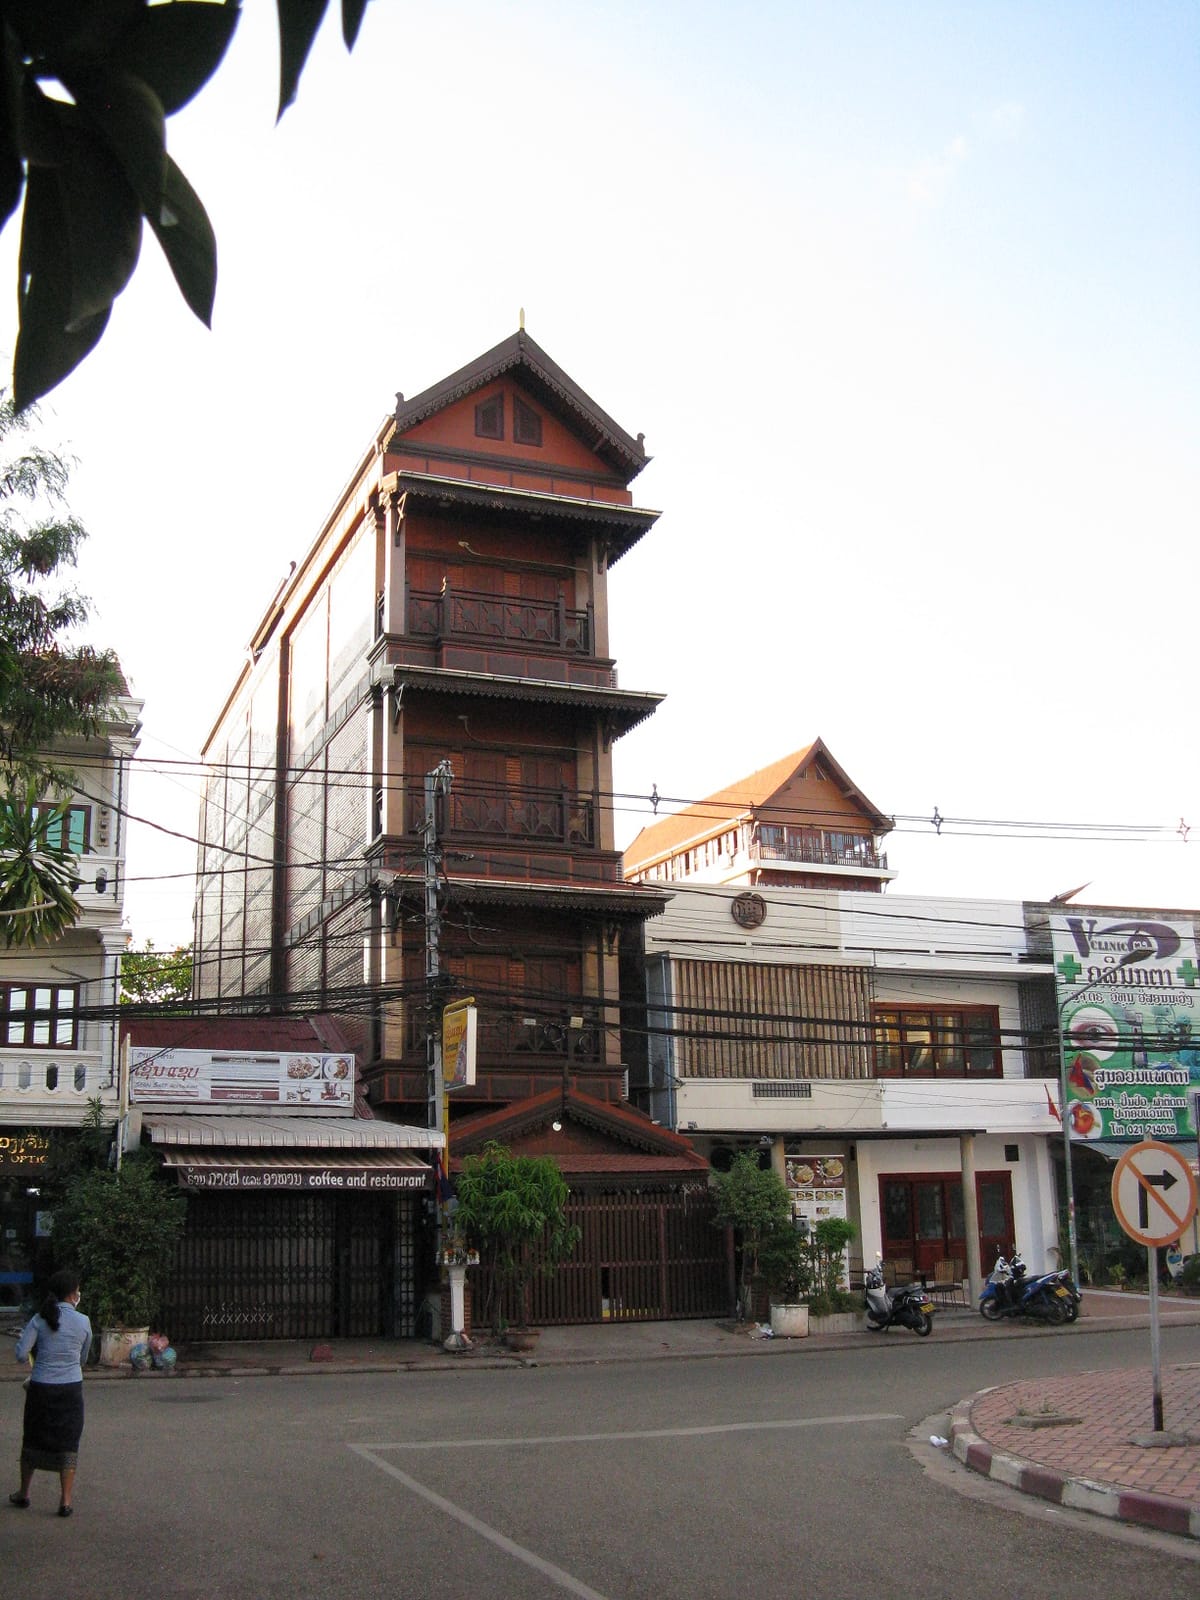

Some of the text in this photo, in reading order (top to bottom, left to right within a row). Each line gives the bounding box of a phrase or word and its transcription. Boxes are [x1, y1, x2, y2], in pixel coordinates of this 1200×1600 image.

[1091, 940, 1129, 952] CLINIC
[1128, 1125, 1143, 1134] 021
[208, 1169, 240, 1186] ກາເຟ
[242, 1175, 262, 1186] ແລະ
[263, 1173, 302, 1186] ອາຫານ
[309, 1171, 343, 1186] coffee
[347, 1172, 367, 1187] and
[370, 1172, 425, 1187] restaurant
